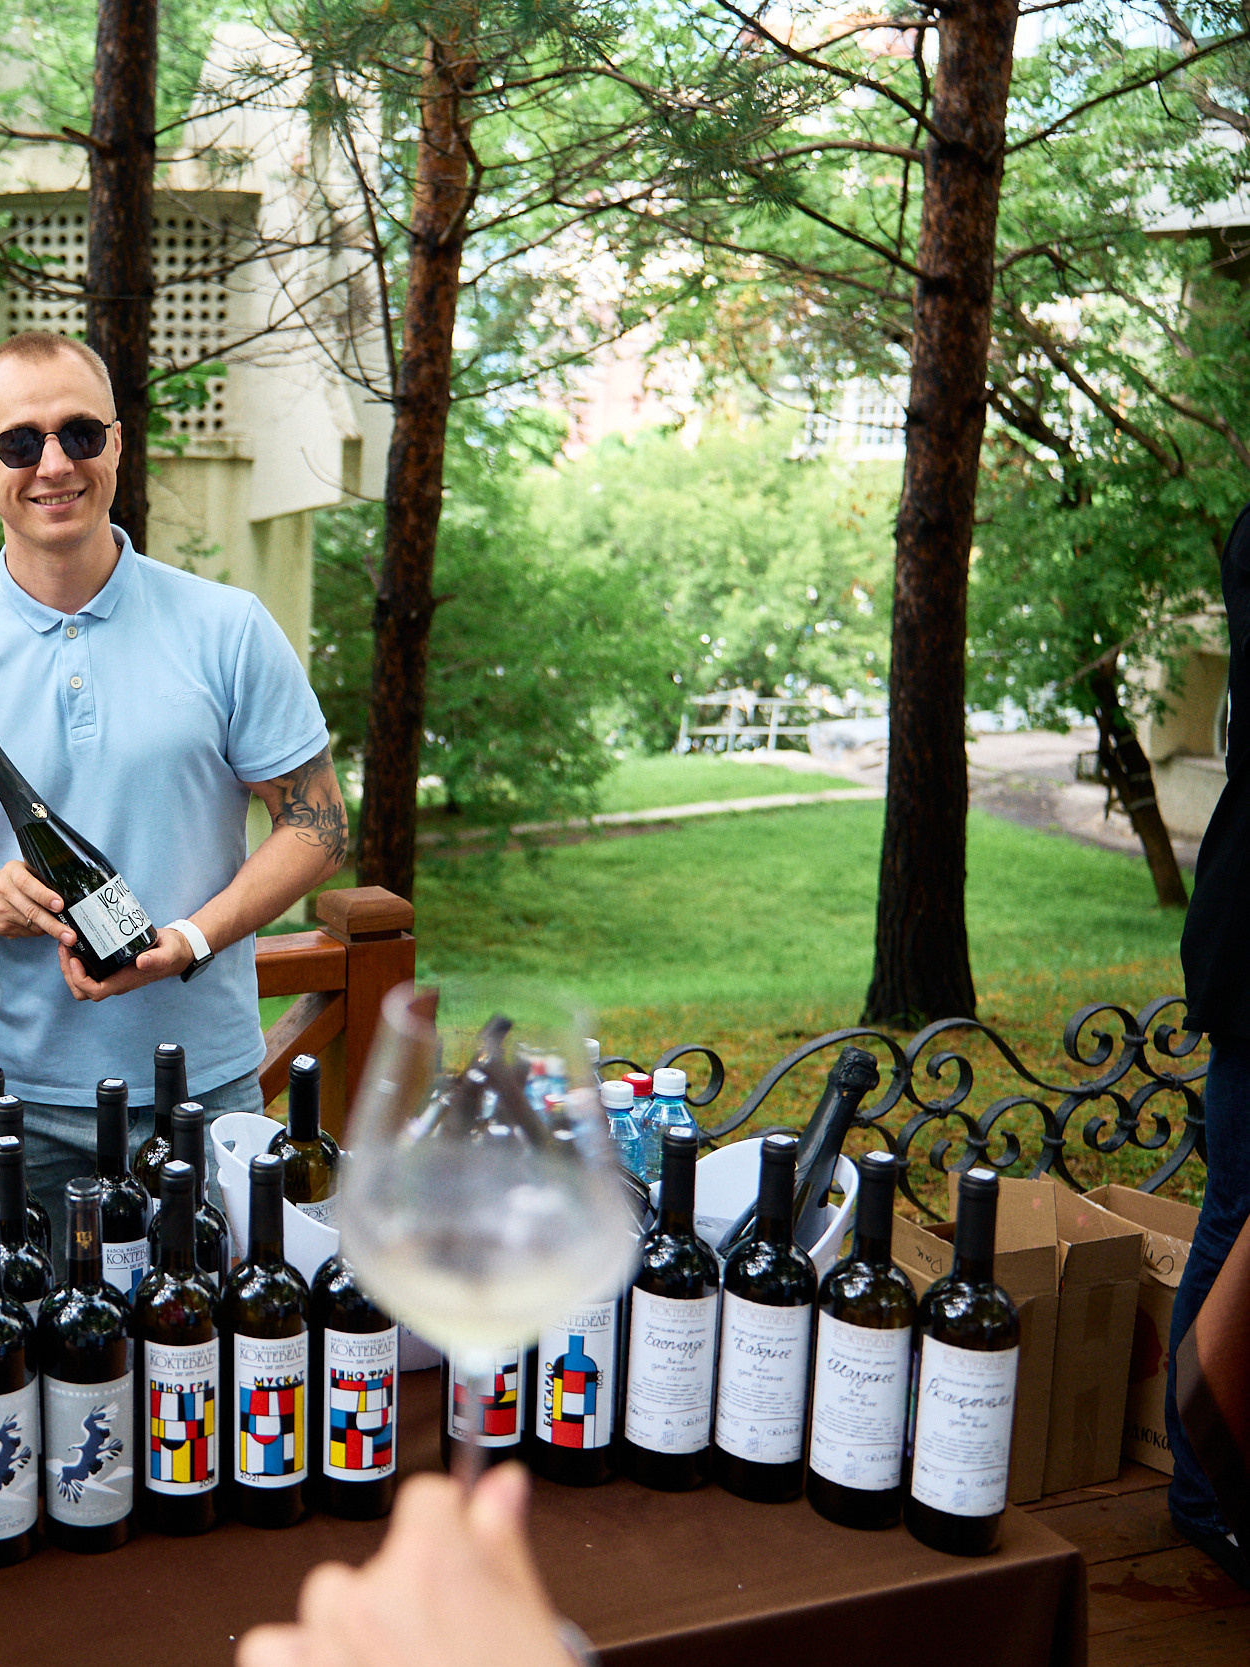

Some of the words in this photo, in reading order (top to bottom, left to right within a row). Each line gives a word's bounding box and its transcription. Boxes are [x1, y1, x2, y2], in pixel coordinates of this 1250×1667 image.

[239, 1346, 306, 1363] КОКТЕБЕЛЬ
[330, 1340, 396, 1358] КОКТЕБЕЛЬ
[150, 1353, 216, 1370] КОКТЕБЕЛЬ
[254, 1370, 305, 1388] МУСКАТ
[543, 1361, 555, 1427] БАСТАРДО
